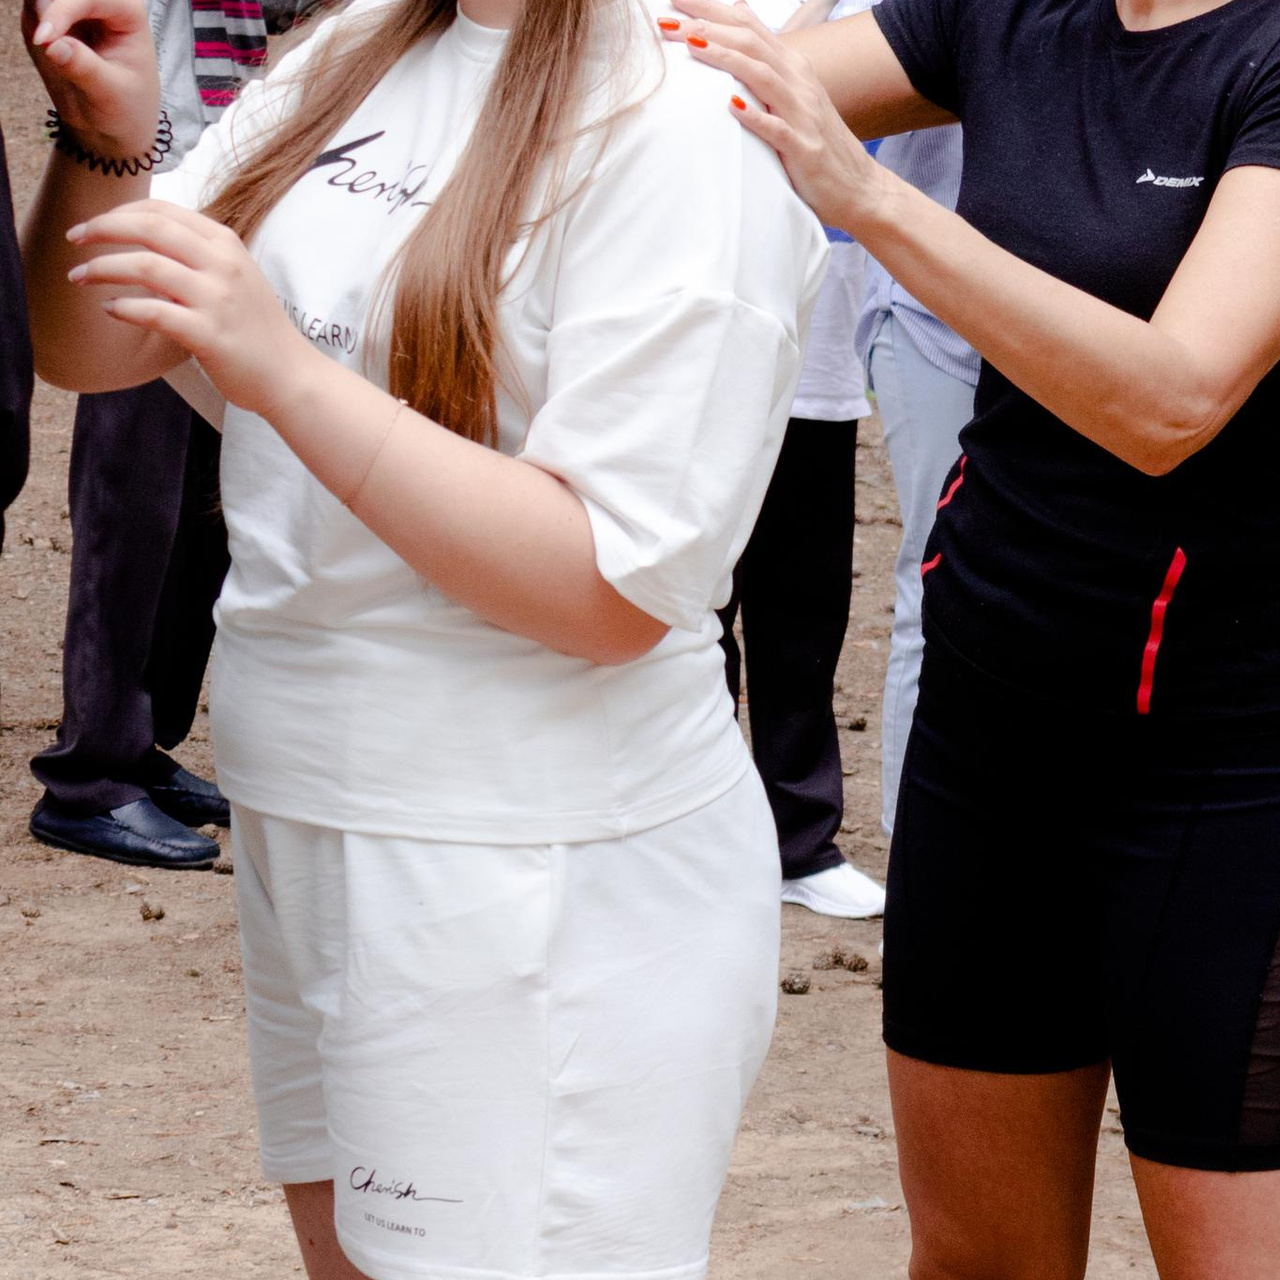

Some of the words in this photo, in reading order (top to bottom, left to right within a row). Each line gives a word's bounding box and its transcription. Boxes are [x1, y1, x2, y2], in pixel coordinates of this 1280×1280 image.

[301, 312, 359, 355] LEARN
[386, 1221, 412, 1235] LEARN
[414, 1227, 426, 1238] TO
